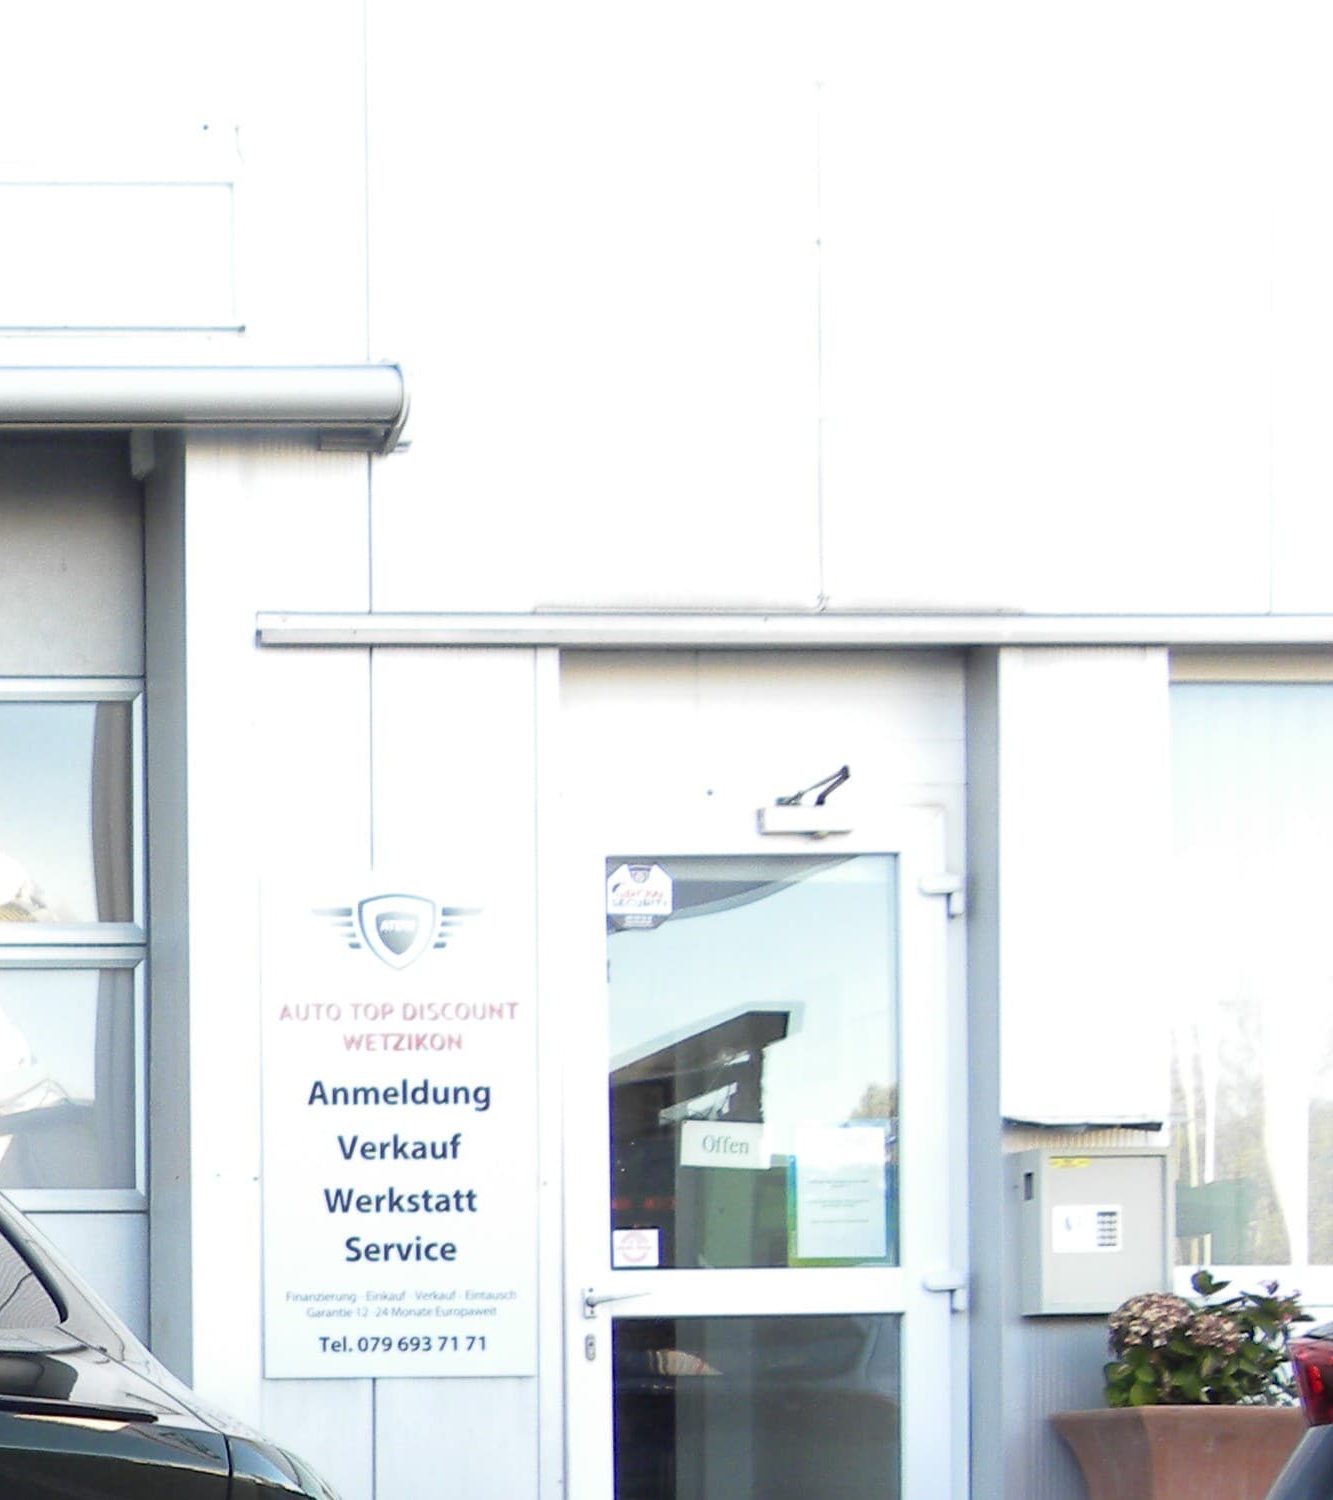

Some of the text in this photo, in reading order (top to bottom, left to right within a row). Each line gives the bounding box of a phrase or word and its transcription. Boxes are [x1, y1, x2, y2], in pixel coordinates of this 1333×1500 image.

[279, 1002, 519, 1021] AUTO TOP DISCOUNT
[343, 1032, 464, 1051] WETZIKON
[308, 1078, 491, 1112] Anmeldung
[337, 1133, 462, 1160] Verkauf
[701, 1134, 749, 1155] Offen
[323, 1186, 478, 1213] Werkstatt
[345, 1235, 458, 1262] Service
[285, 1289, 517, 1304] Finanzierung Einkauf Verkauf Eintausch
[306, 1307, 353, 1318] Garantie
[391, 1307, 432, 1318] Monate
[435, 1306, 497, 1319] Europaweit
[319, 1336, 487, 1352] Tel. 079 693 71 71
